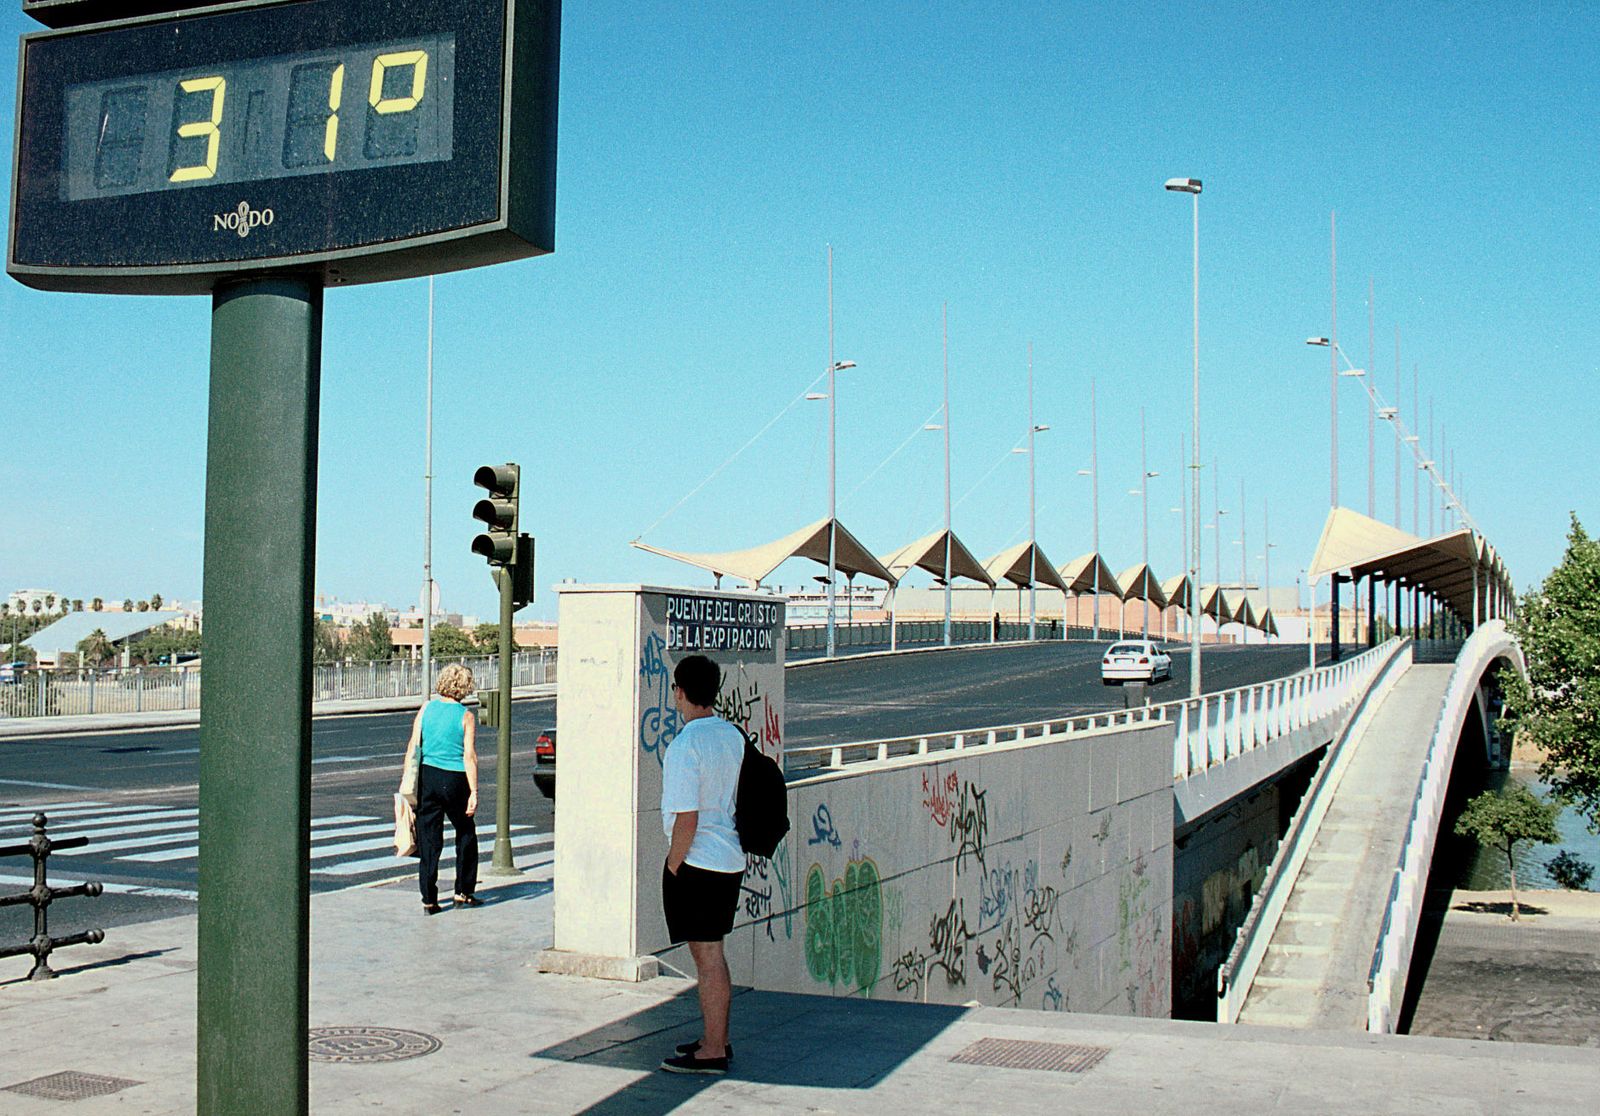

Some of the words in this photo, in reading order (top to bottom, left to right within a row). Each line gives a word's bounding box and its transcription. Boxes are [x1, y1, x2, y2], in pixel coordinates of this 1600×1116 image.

[667, 597, 713, 621] PUENTE
[715, 601, 736, 623] DEL
[737, 603, 777, 624] CRISTO
[668, 625, 684, 647] DE
[685, 626, 701, 647] LA
